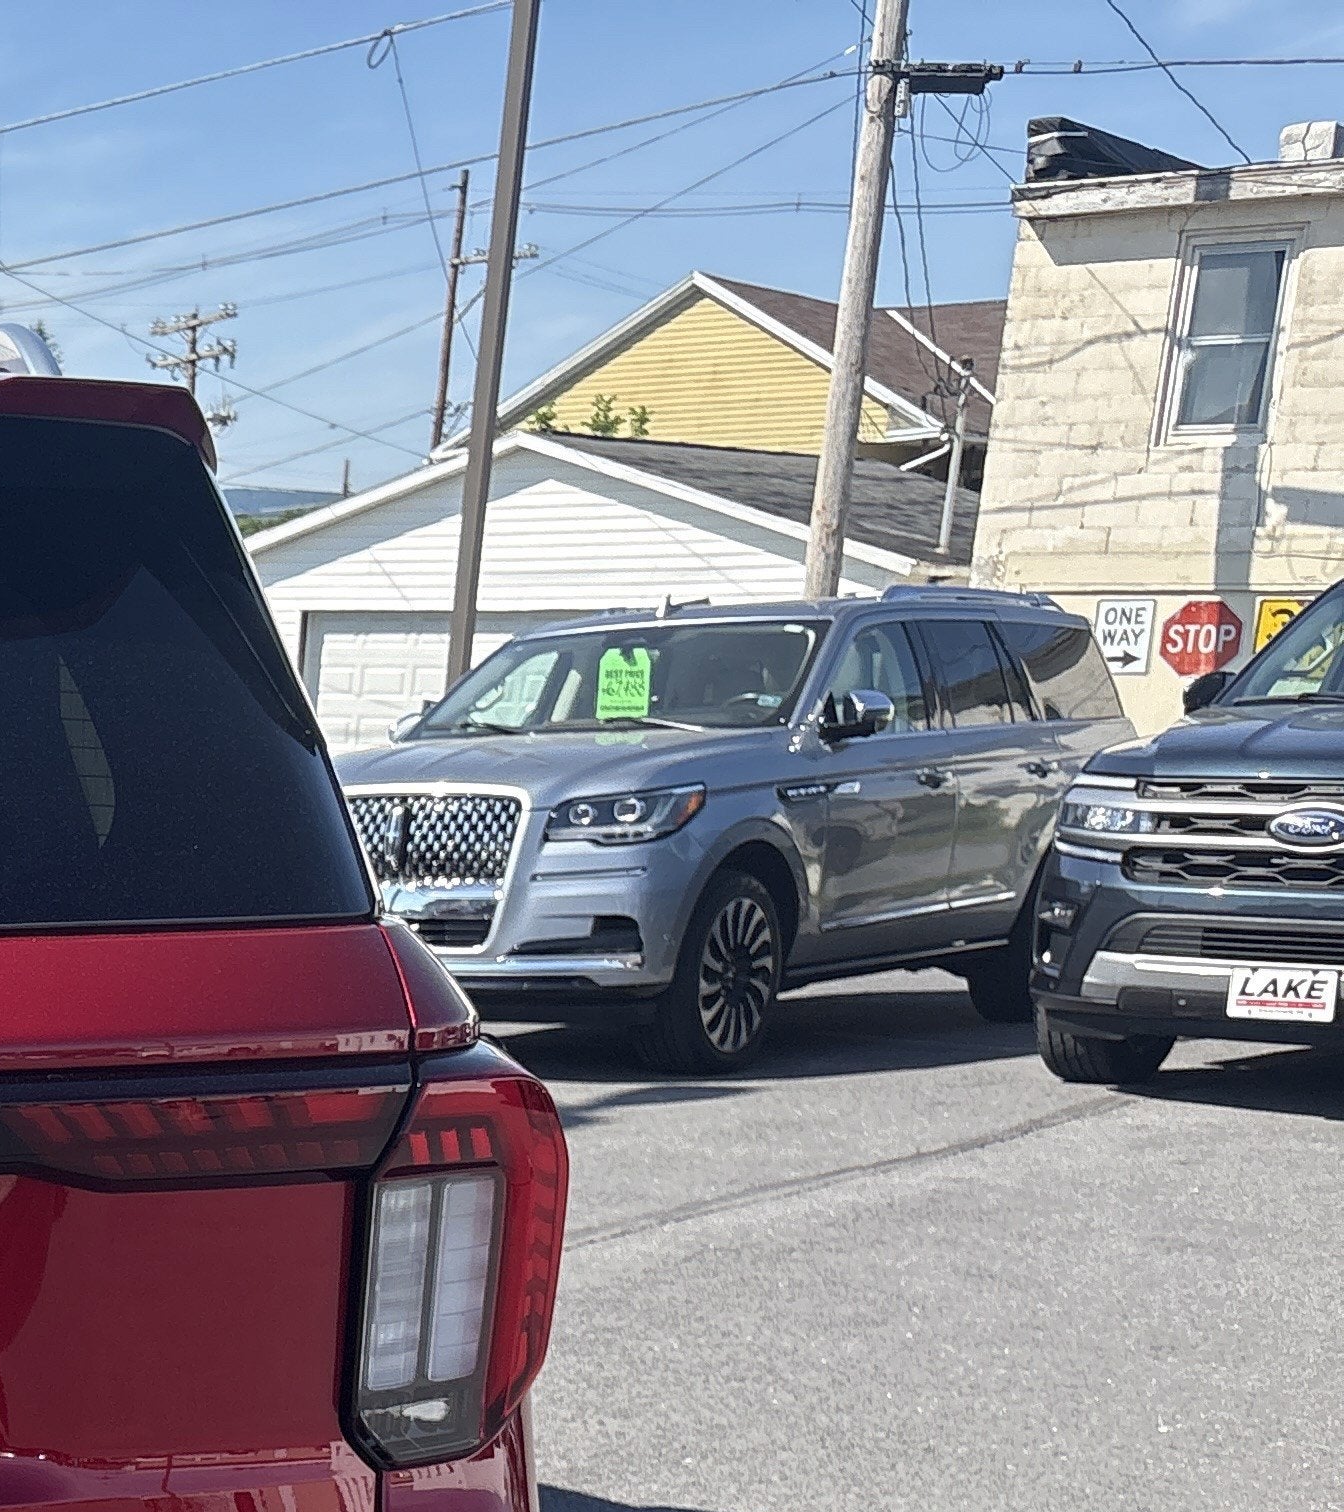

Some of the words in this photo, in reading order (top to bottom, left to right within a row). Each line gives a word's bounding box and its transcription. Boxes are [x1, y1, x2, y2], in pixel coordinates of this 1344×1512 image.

[1104, 606, 1147, 626] ONE
[1102, 628, 1145, 647] WAY
[1165, 623, 1238, 654] STOP
[1238, 976, 1329, 1000] LAKE
